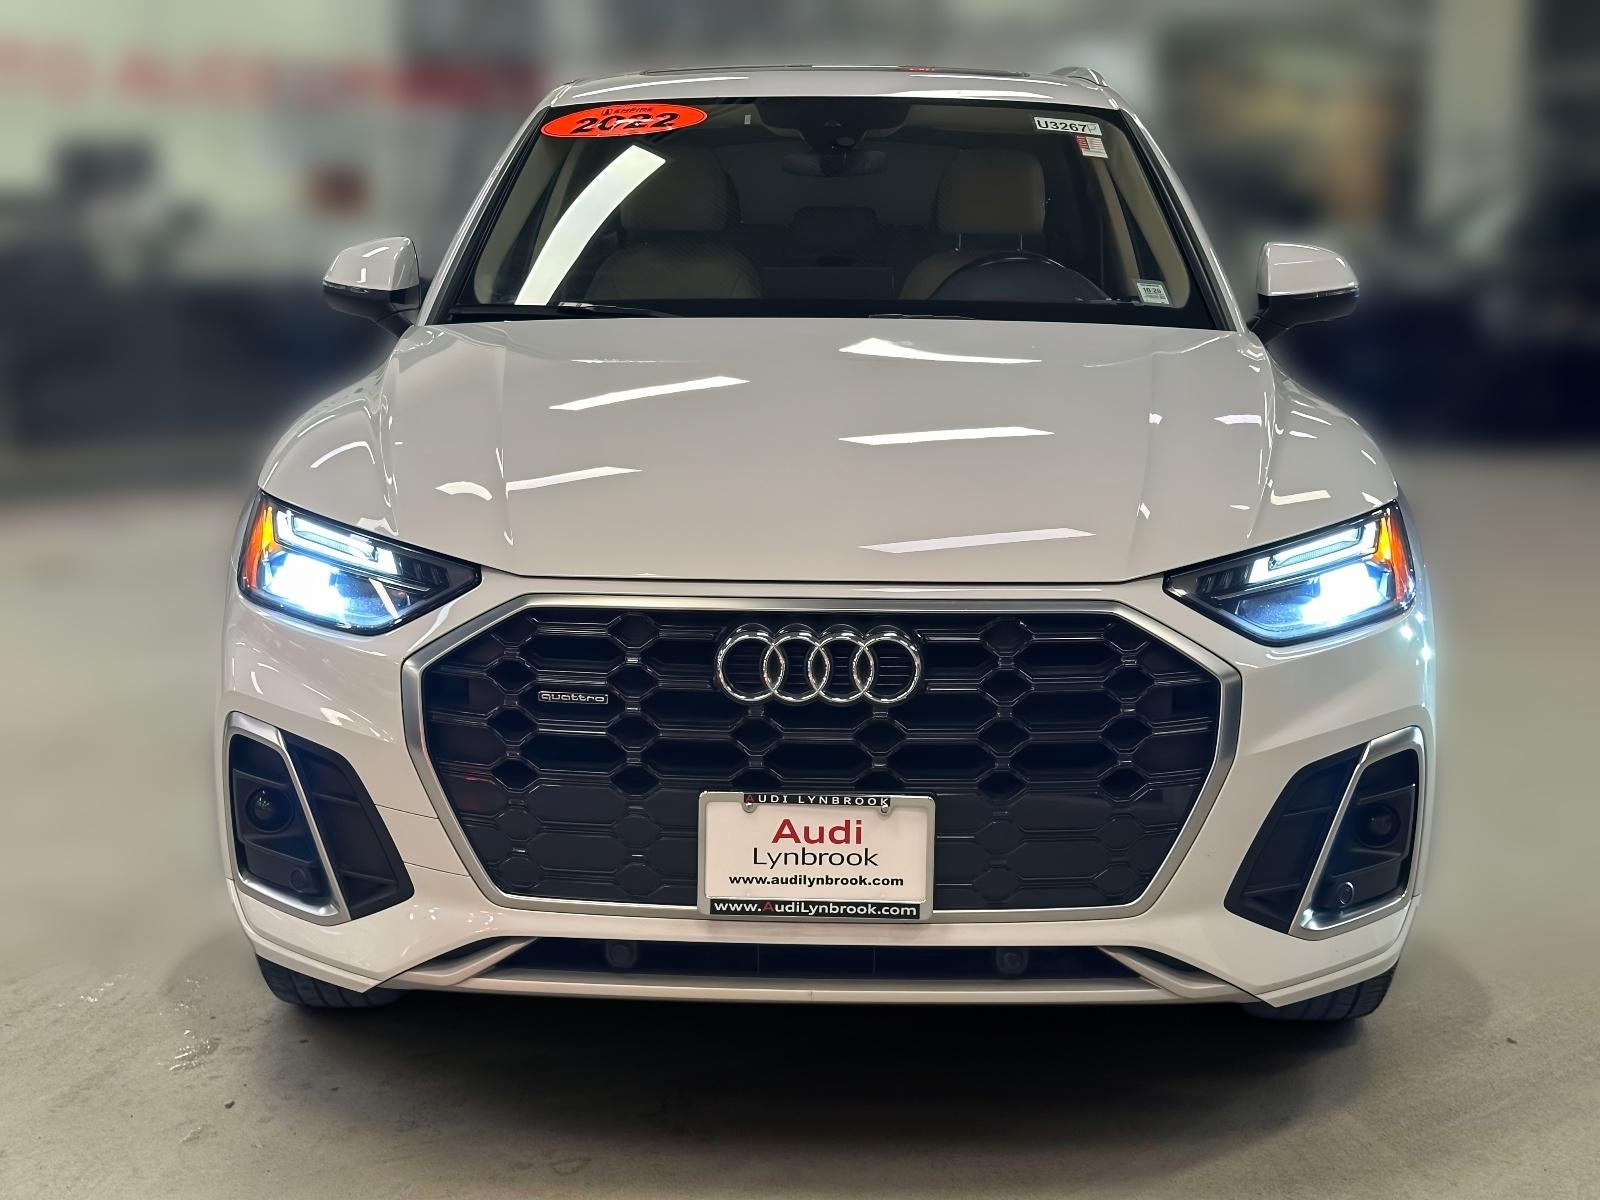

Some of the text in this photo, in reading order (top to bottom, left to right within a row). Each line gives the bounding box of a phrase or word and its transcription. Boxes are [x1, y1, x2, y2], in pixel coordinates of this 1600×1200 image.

[569, 112, 680, 134] 2022
[541, 693, 605, 702] quattro
[746, 794, 888, 807] AUDI LYNBROOK
[772, 818, 863, 845] Audi
[753, 847, 879, 869] Lynbrook
[728, 874, 904, 887] www.audilynbrook.com
[714, 901, 917, 916] www.AudiLynbrook.com
